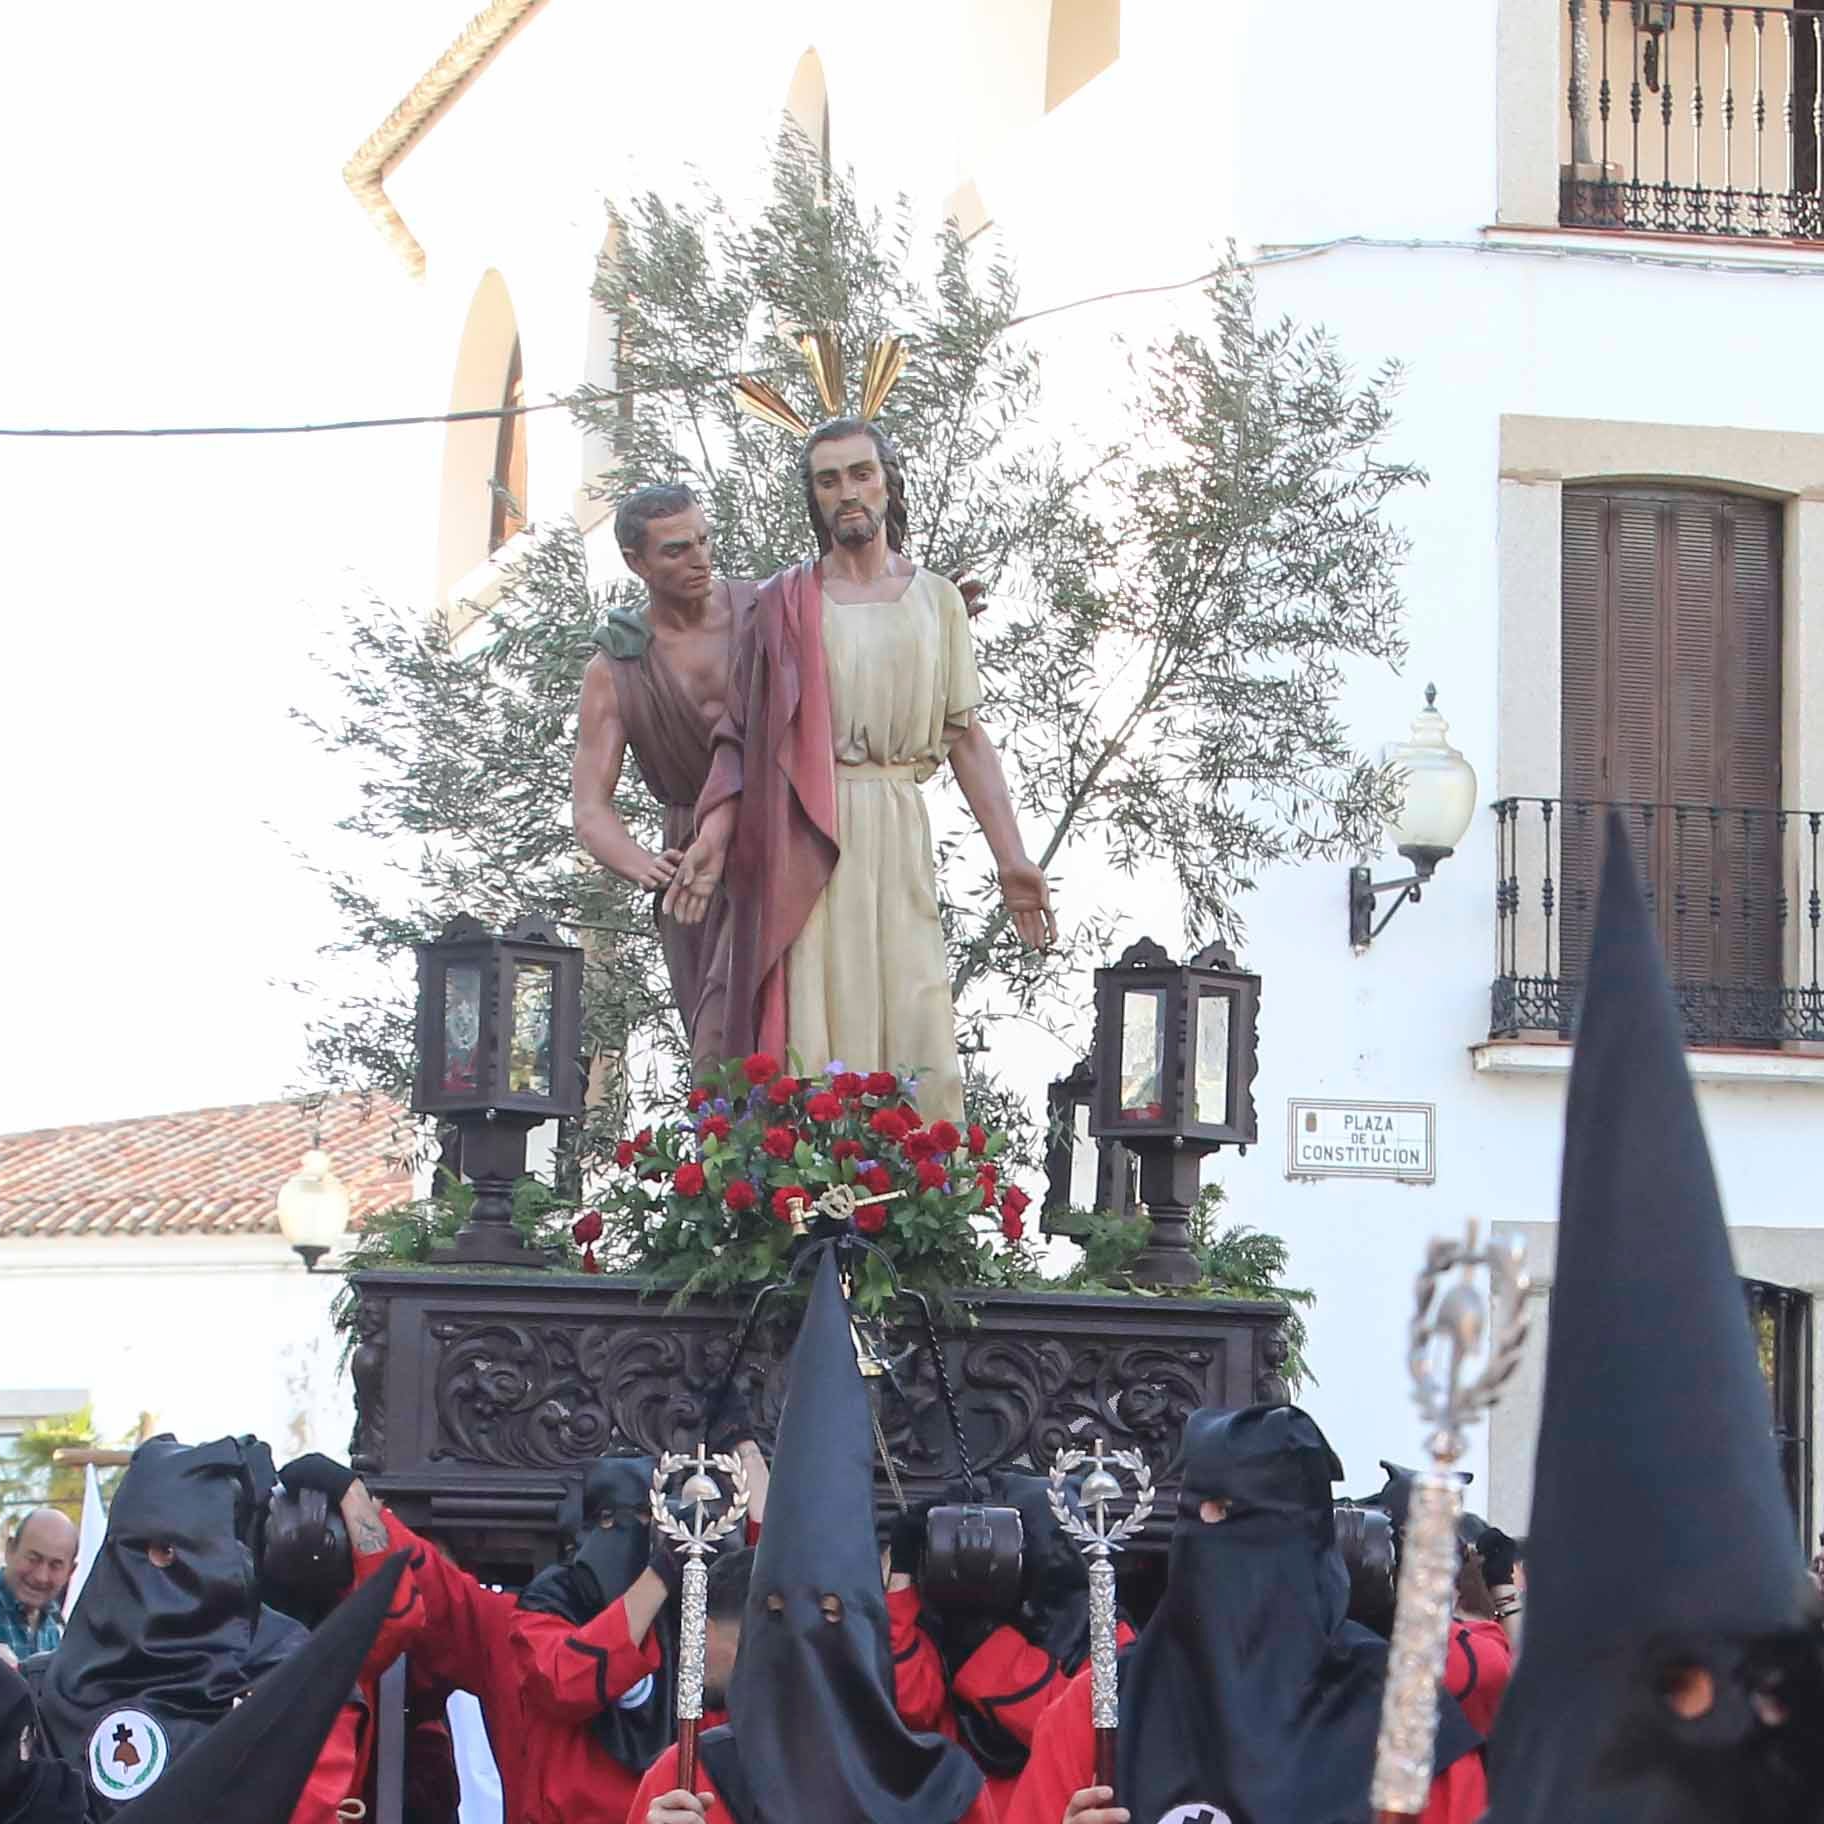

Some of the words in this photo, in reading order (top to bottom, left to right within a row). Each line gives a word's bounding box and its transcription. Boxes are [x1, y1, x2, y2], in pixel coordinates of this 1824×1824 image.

[1344, 1114, 1394, 1131] PLAZA
[1351, 1133, 1366, 1144] DE
[1372, 1133, 1386, 1145] LA
[1302, 1145, 1420, 1164] CONSTITUCION
